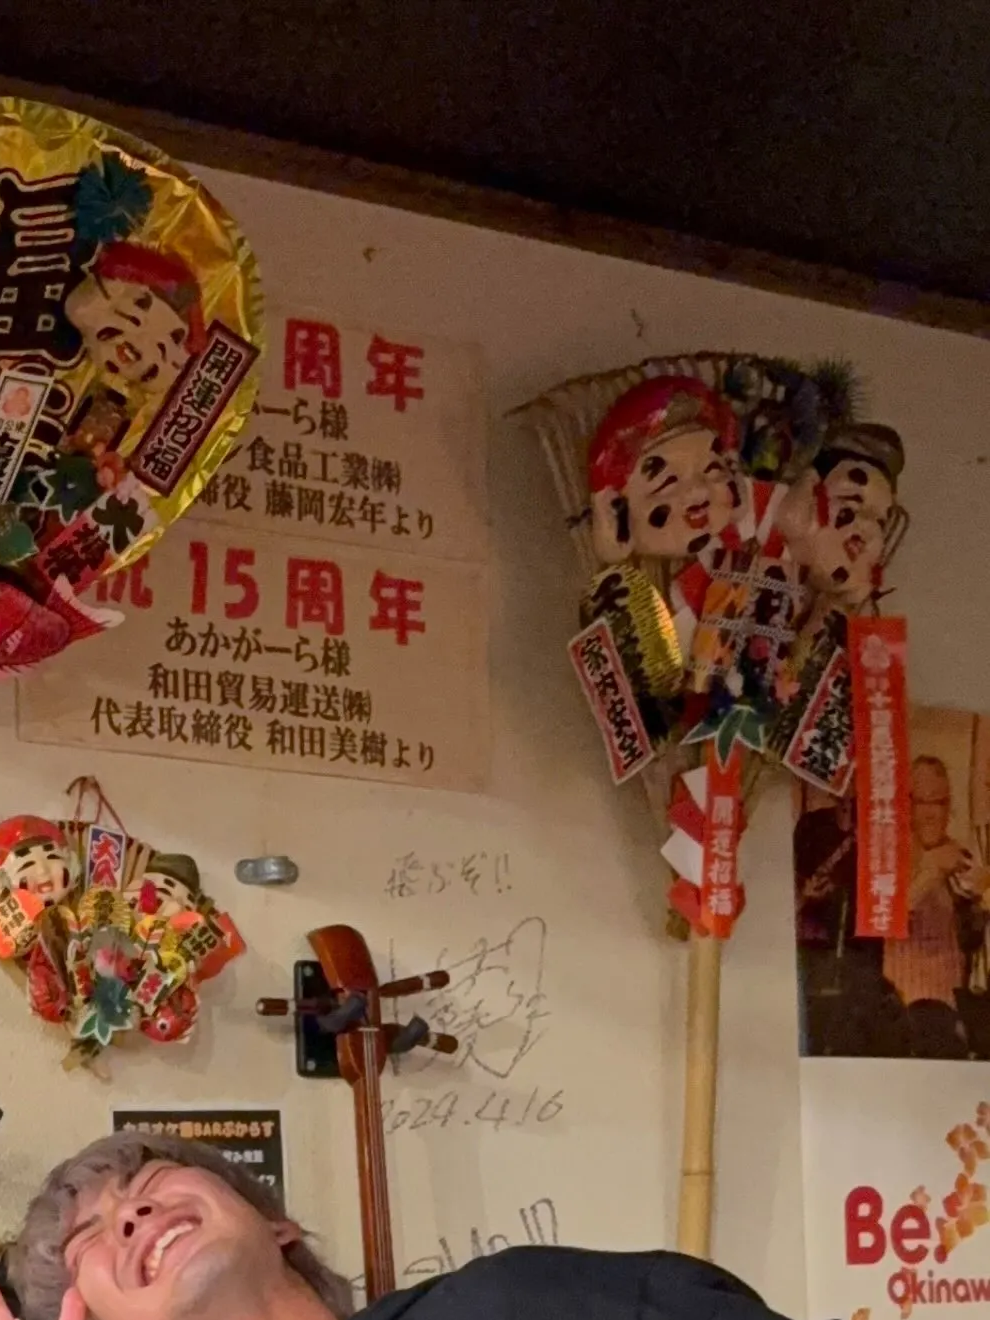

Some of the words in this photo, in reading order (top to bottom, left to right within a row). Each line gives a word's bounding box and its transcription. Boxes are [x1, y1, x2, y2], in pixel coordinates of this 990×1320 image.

[252, 396, 350, 442] ーら様
[165, 616, 352, 678] あかがーら様
[90, 697, 254, 754] 代表取締役
[266, 718, 436, 772] 和田美樹より
